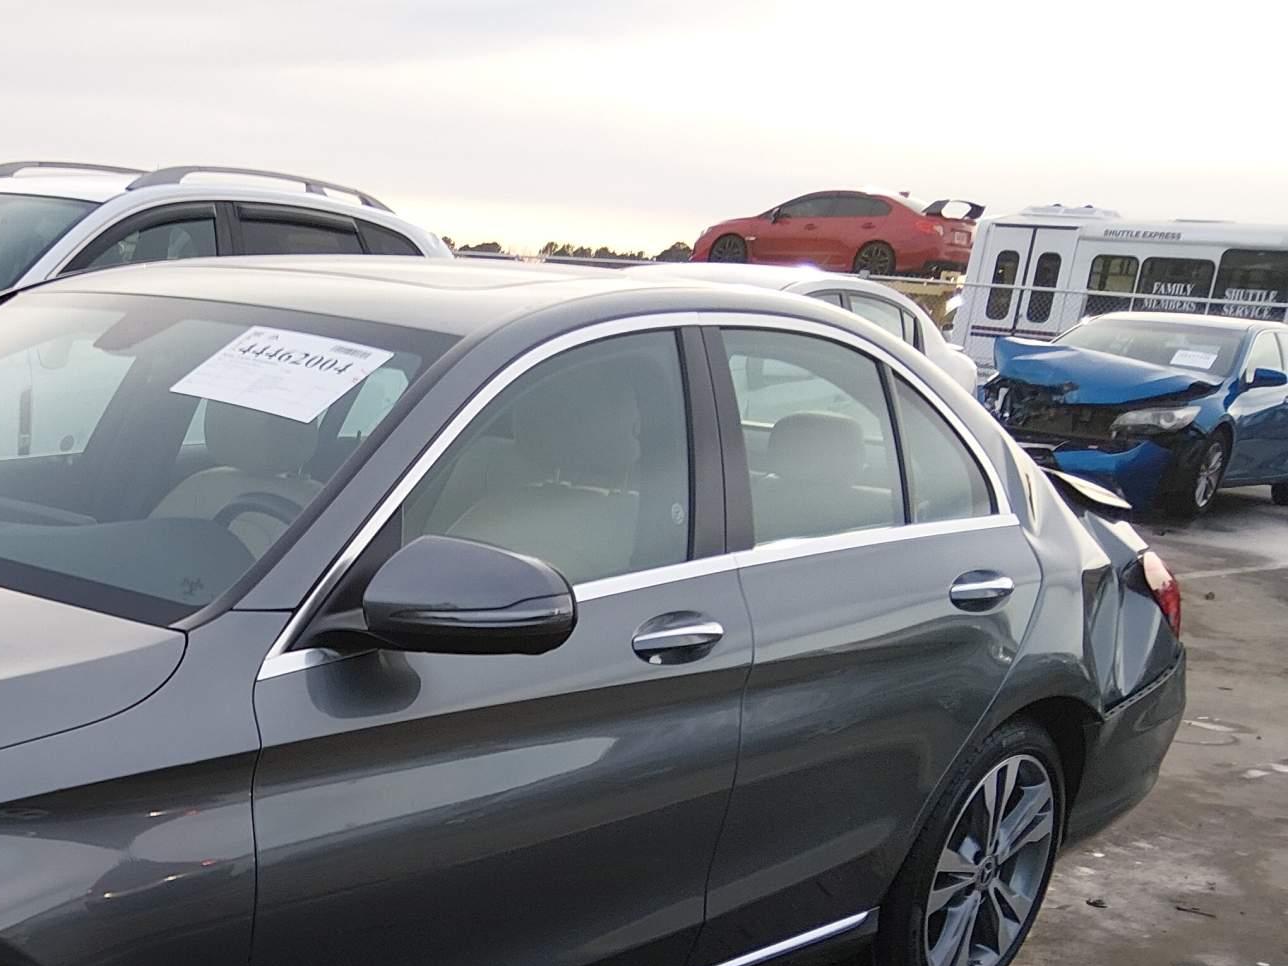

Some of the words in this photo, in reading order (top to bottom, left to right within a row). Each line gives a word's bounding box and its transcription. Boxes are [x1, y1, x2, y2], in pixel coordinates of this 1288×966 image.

[1103, 228, 1140, 239] SHUTTLE
[1141, 230, 1182, 241] EXPRESS
[1152, 281, 1195, 297] FAMILY
[1224, 288, 1279, 303] SHUTTLE
[1142, 299, 1197, 312] MEMBERS
[1222, 303, 1272, 319] SERVICE
[238, 343, 354, 375] 44462004
